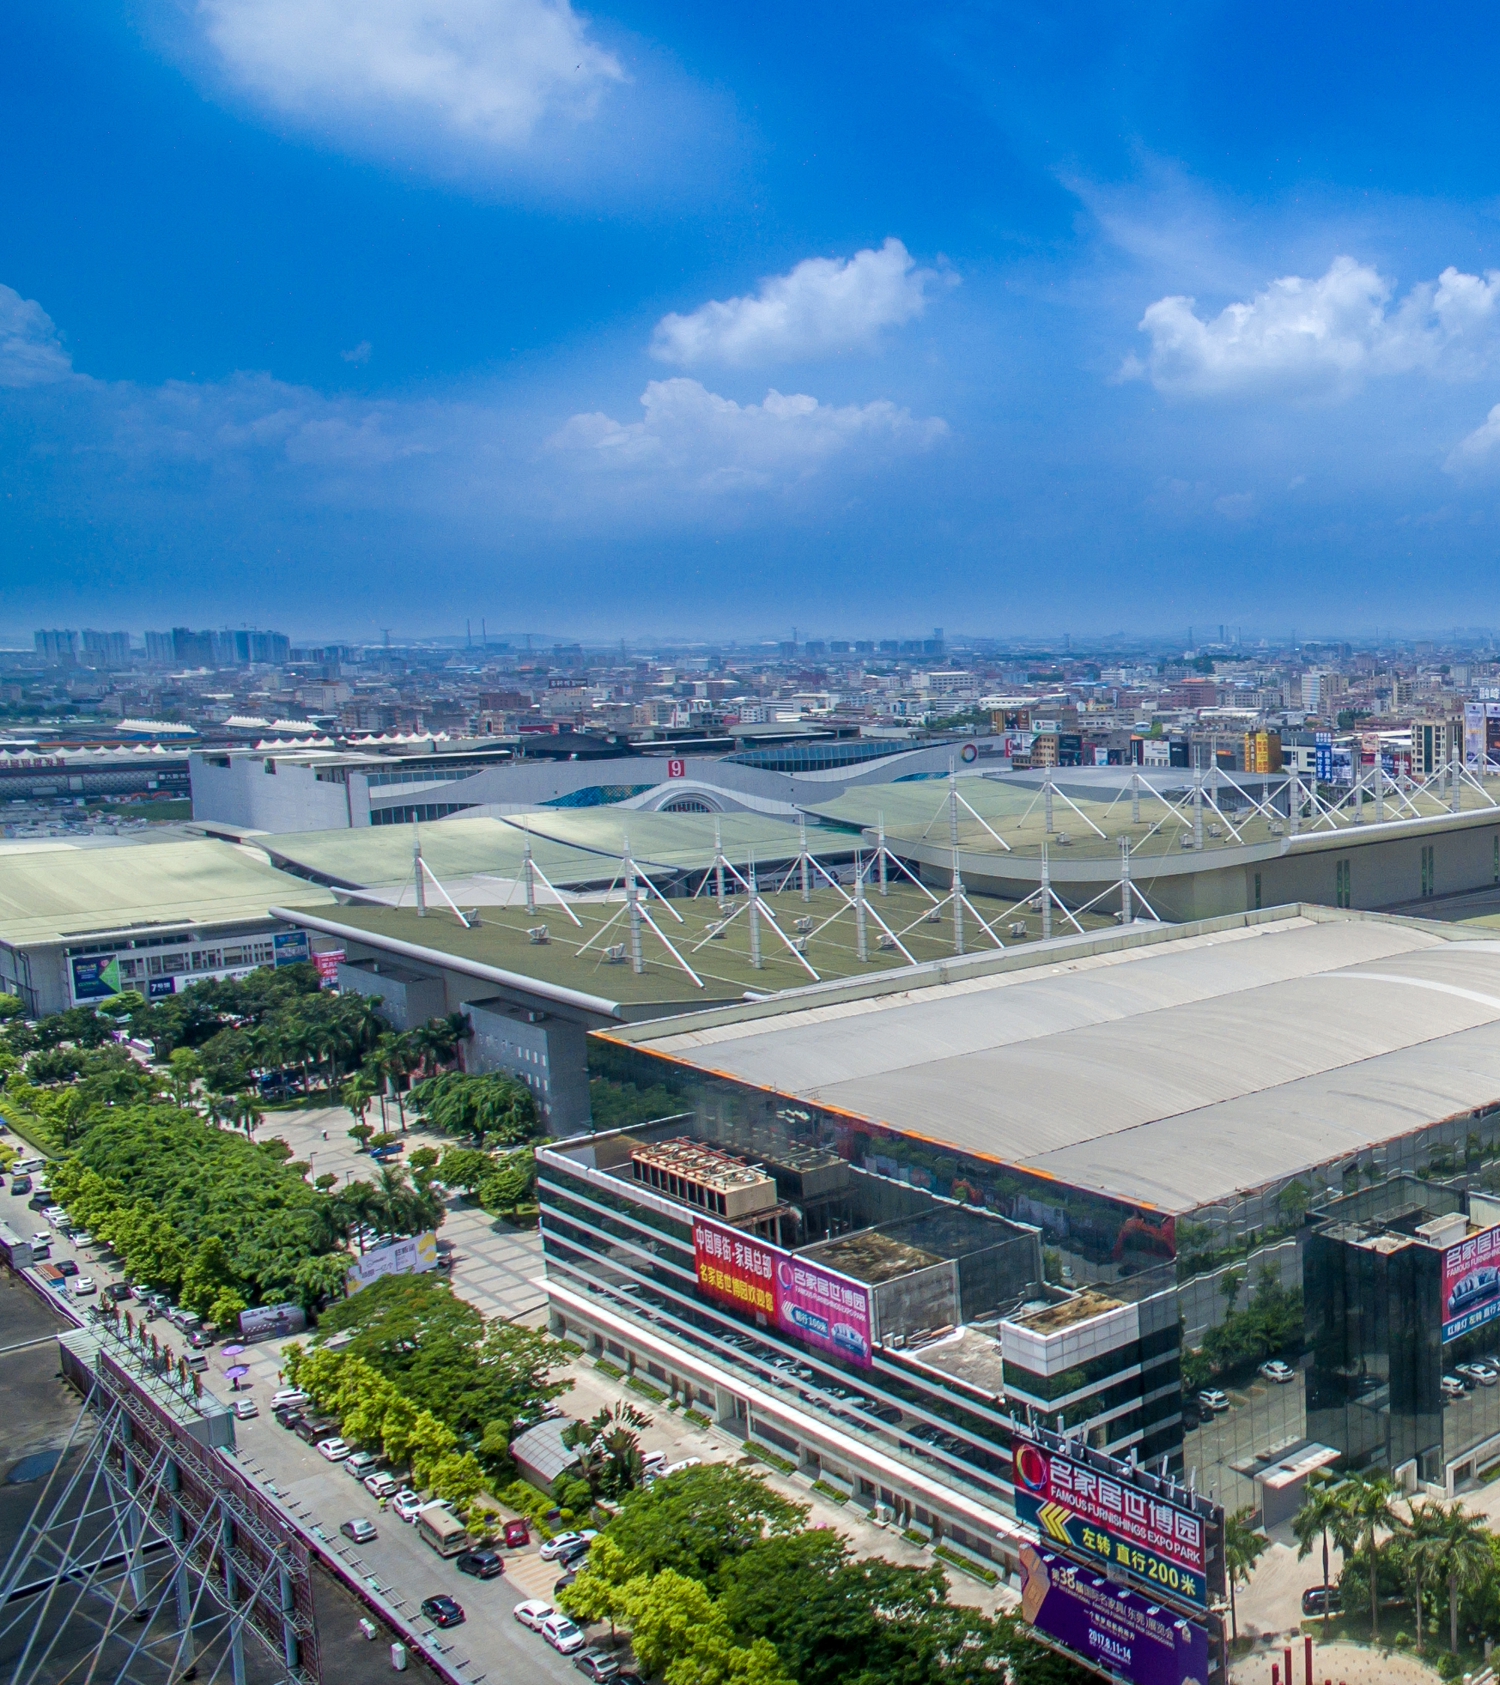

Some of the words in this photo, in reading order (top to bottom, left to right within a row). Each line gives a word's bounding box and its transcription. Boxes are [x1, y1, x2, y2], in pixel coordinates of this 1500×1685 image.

[671, 760, 682, 776] 9
[699, 1262, 775, 1313] 名家居世博园欢迎您
[794, 1267, 867, 1313] 名家居世博园
[1446, 1262, 1471, 1279] FAMOUS
[1447, 1318, 1468, 1337] 红绿灯
[1468, 1310, 1483, 1325] 左转
[1050, 1456, 1201, 1548] 名家居世博园
[1050, 1486, 1088, 1513] FAMOUS
[1087, 1503, 1147, 1539] FURNISHINGS
[1147, 1529, 1174, 1550] EXPO
[1173, 1542, 1201, 1564] PARK
[1082, 1527, 1111, 1556] 左转
[1116, 1542, 1197, 1597] 直行200米
